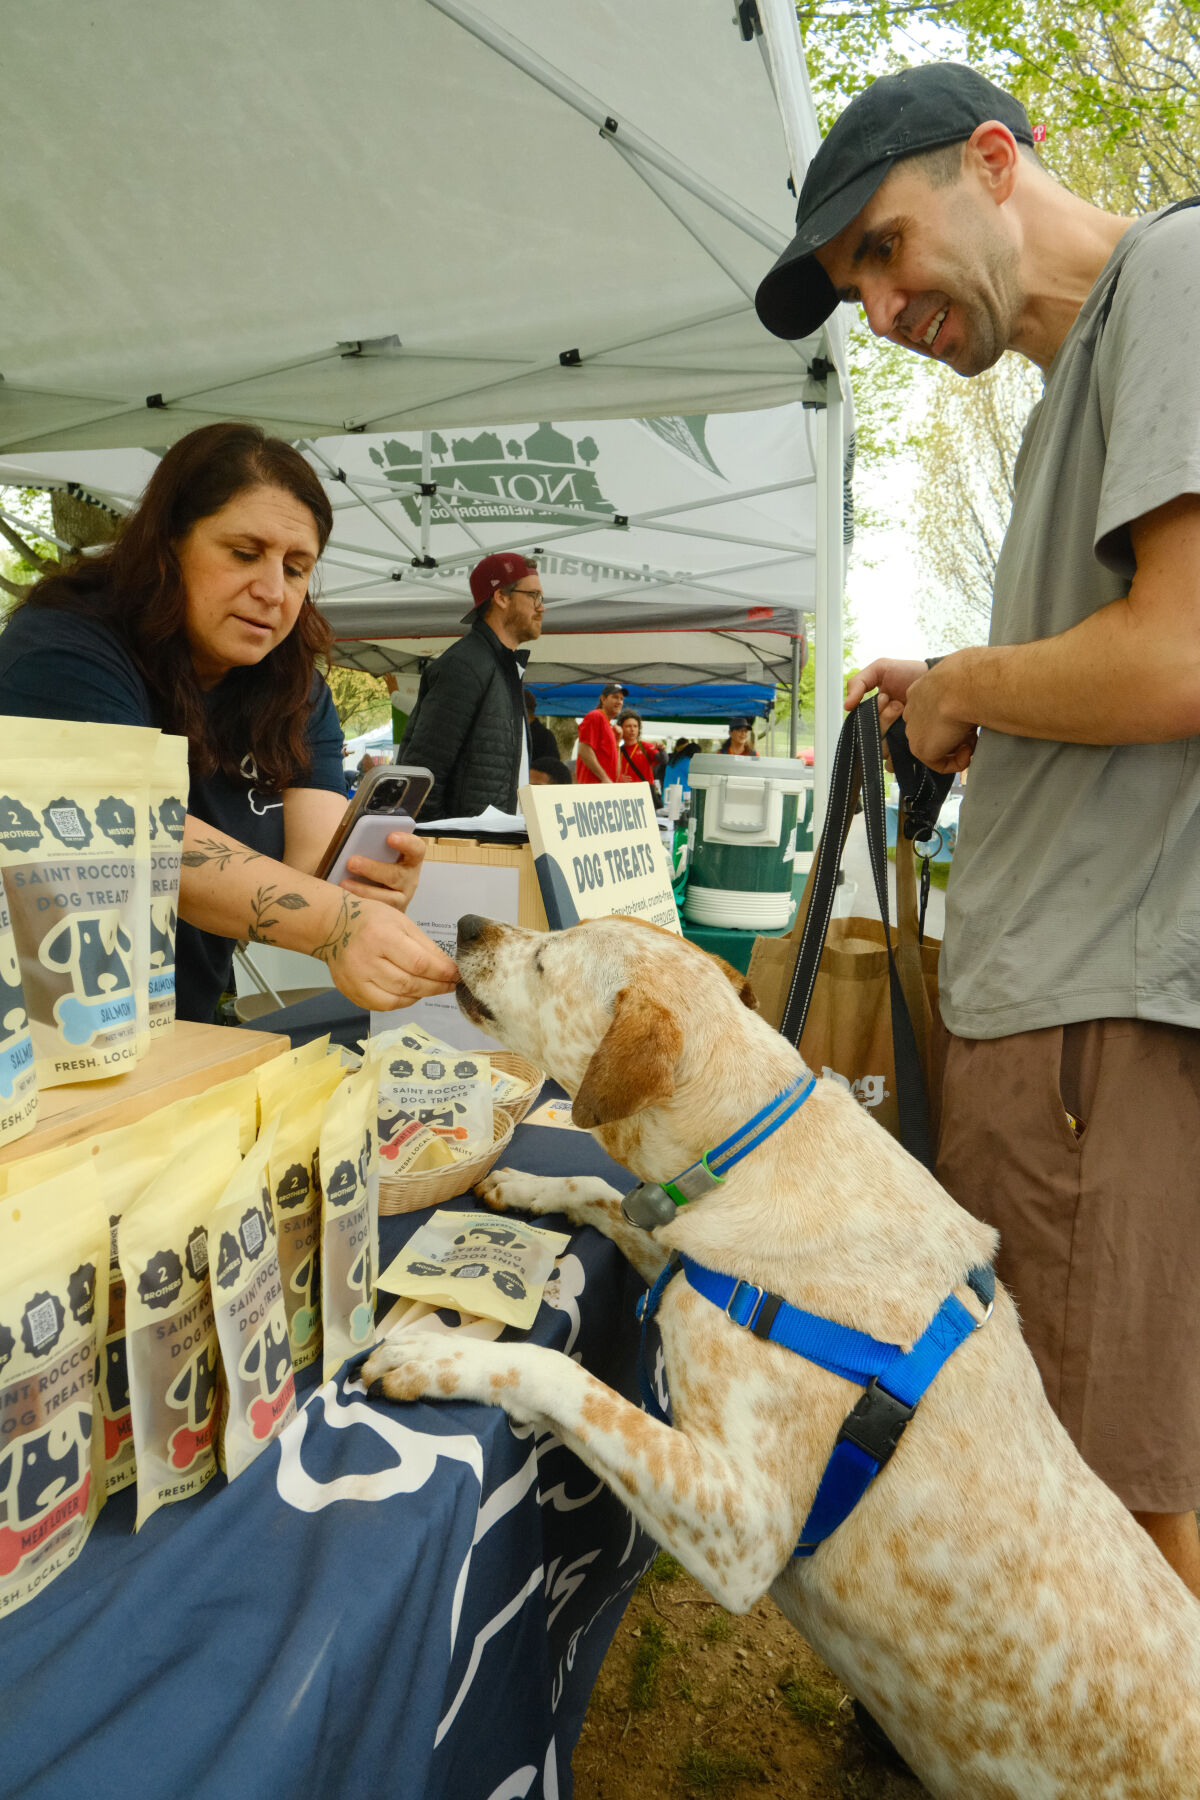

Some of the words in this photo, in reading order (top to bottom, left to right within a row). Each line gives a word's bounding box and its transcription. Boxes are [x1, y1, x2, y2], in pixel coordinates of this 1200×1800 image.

[8, 811, 21, 825] 2
[113, 811, 122, 824] 1
[554, 797, 648, 841] 5-INGREDIENT
[150, 857, 179, 870] OCCO
[572, 852, 604, 894] DOG
[604, 843, 655, 885] TREATS
[14, 866, 71, 888] SAINT
[77, 864, 135, 881] ROCCO'S
[37, 891, 82, 912] DOG
[87, 889, 129, 906] TREATS
[100, 1001, 131, 1023] SALMON
[149, 1017, 172, 1029] OCAL.
[10, 1042, 32, 1070] SALMO
[55, 1058, 100, 1073] FRESH.
[392, 1087, 423, 1095] SAINT
[290, 1176, 298, 1189] 2
[340, 1172, 348, 1186] 2
[349, 1225, 368, 1247] DOG
[157, 1266, 168, 1284] 2
[256, 1258, 279, 1287] ROCC
[492, 1254, 527, 1275] SAINT
[83, 1281, 91, 1296] 1
[144, 1277, 182, 1302] BROTHERS
[505, 1282, 514, 1291] 2
[156, 1304, 198, 1340] SAINT
[240, 1303, 266, 1333] DOG
[170, 1327, 201, 1359] DOG
[1, 1410, 37, 1434] OG
[44, 1368, 95, 1416] TREATS
[158, 1480, 197, 1500] FRESH.
[21, 1521, 50, 1550] MEAT
[50, 1495, 79, 1526] LOVER
